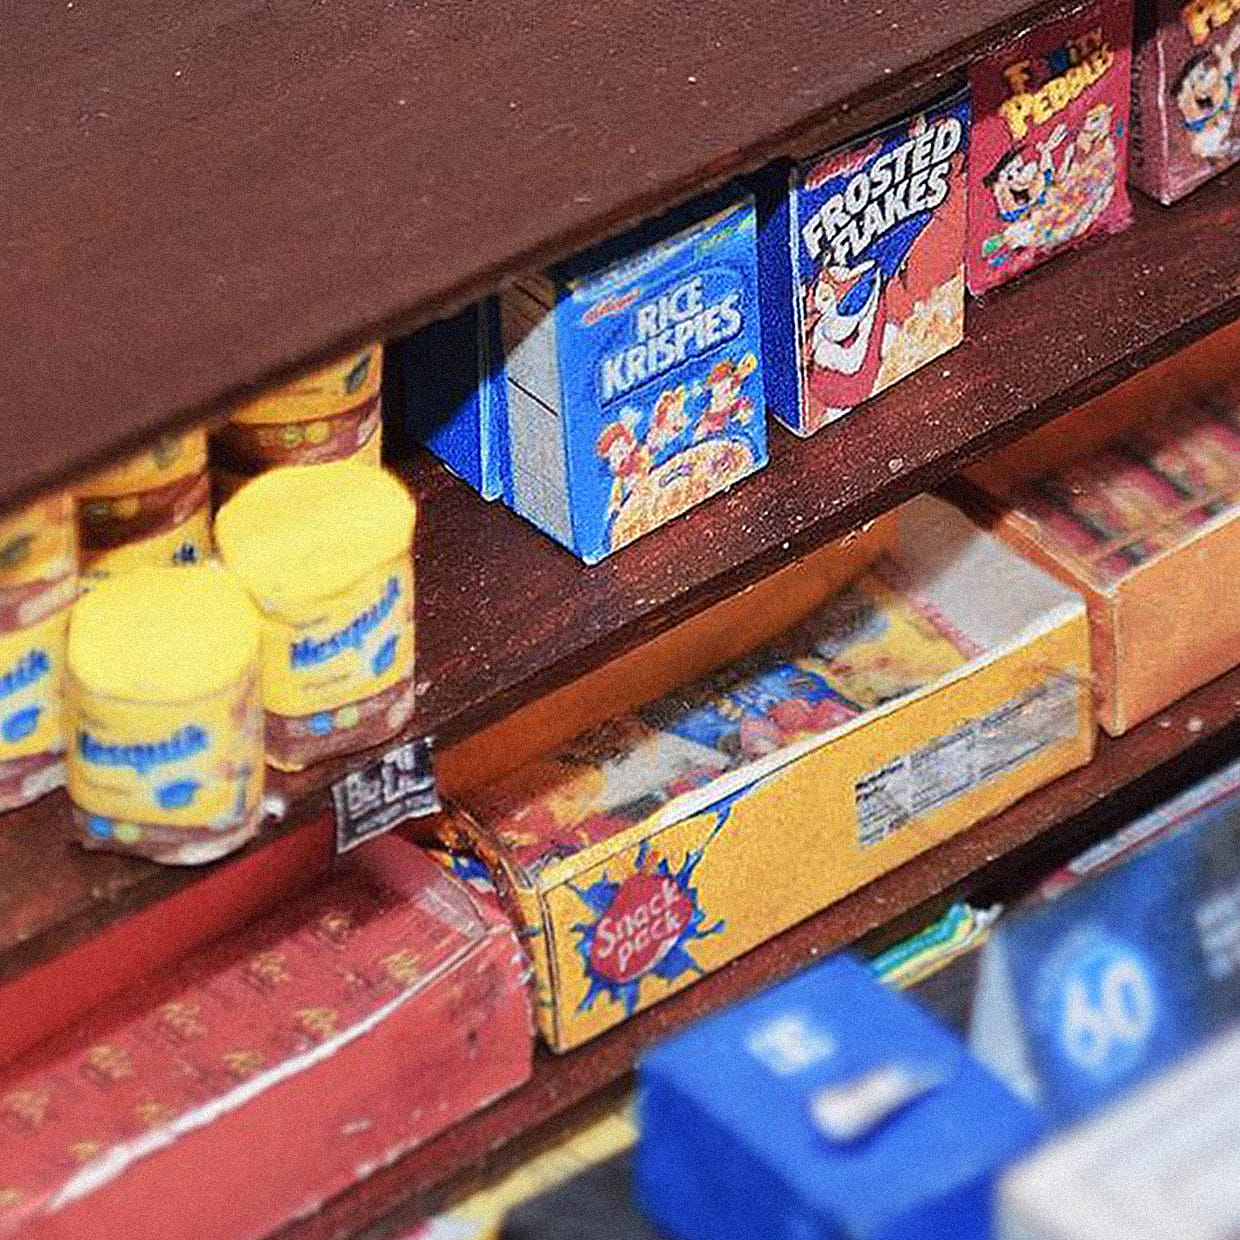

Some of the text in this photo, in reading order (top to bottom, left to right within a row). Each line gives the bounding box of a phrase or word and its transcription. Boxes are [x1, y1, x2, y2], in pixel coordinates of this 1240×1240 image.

[801, 117, 963, 259] FROSTED
[830, 162, 949, 265] FLAKES
[600, 292, 743, 404] KRISPIES
[637, 274, 705, 344] RICE
[596, 878, 681, 958] Snack
[1062, 955, 1154, 1067] 60
